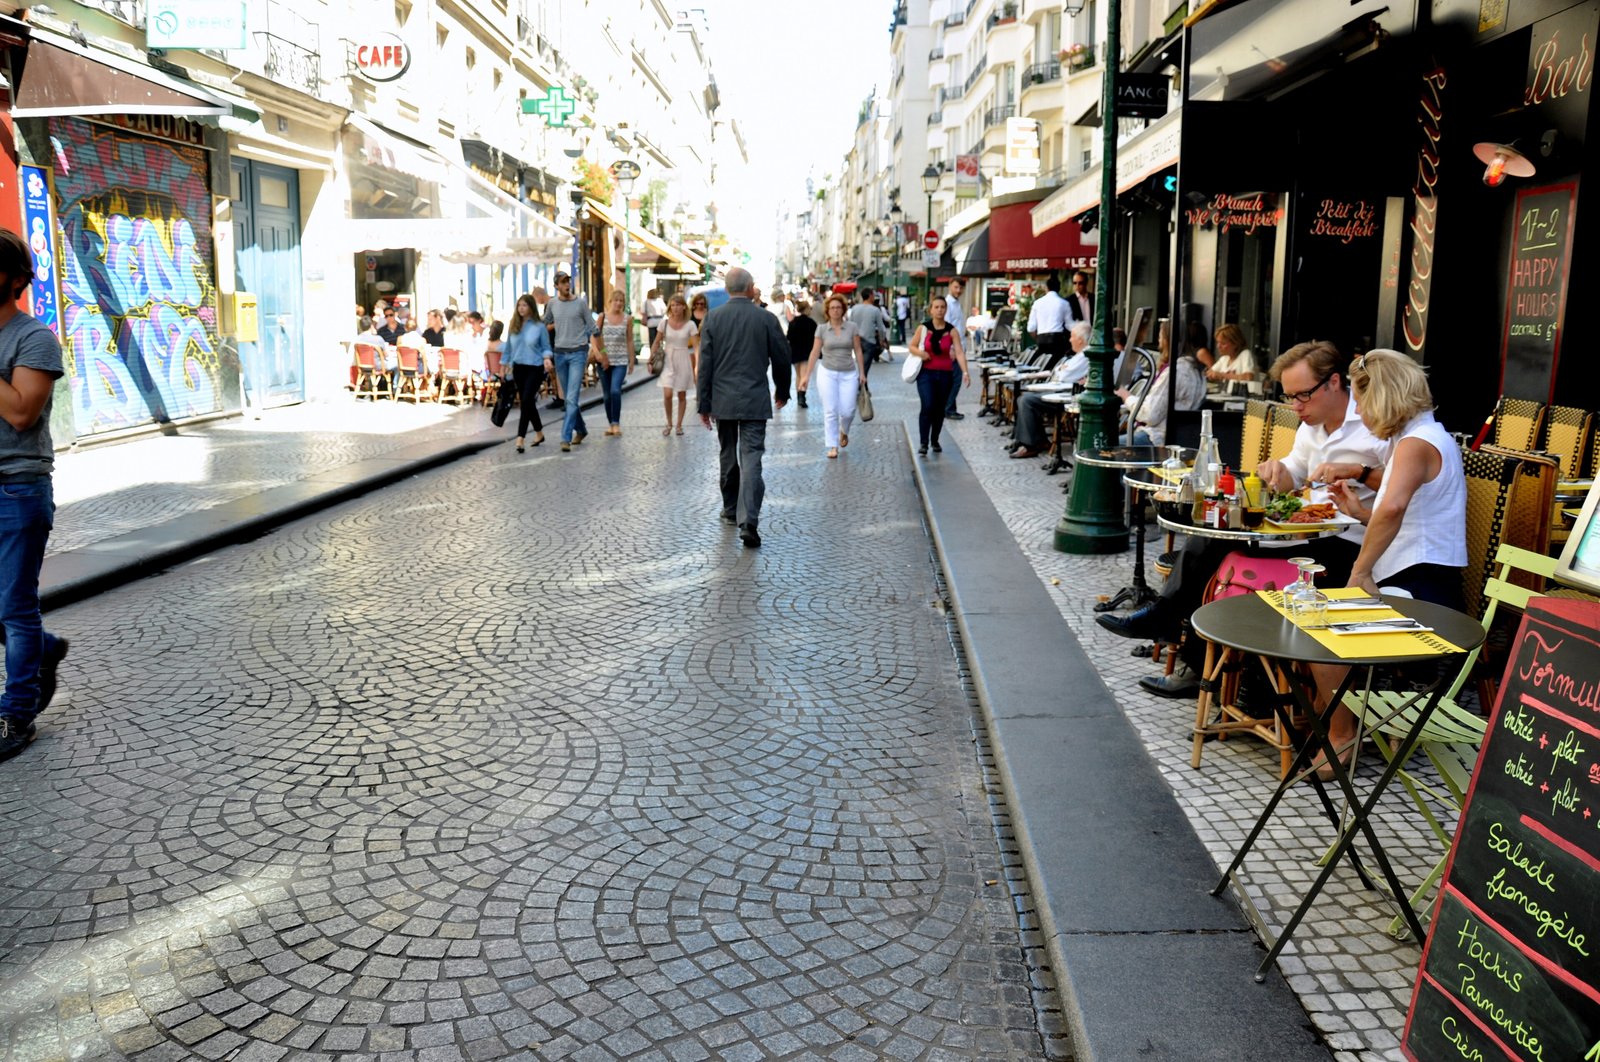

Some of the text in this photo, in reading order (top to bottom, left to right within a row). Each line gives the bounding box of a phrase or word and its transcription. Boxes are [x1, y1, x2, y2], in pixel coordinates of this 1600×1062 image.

[357, 45, 403, 67] CAFE
[1524, 30, 1593, 106] Bar
[1207, 192, 1264, 211] Brunch
[1316, 199, 1353, 219] Petit
[1402, 58, 1447, 350] Cocktails
[1309, 219, 1379, 244] Breakfast
[1006, 258, 1049, 270] BRASSERIE
[1514, 256, 1558, 288] HAPPY
[35, 297, 46, 317] 5
[45, 291, 53, 304] 2
[1516, 292, 1558, 317] HOURS
[45, 308, 56, 326] 7
[1503, 704, 1534, 742] entrée
[1551, 729, 1585, 776] plat
[1504, 752, 1534, 786] entrée
[1551, 777, 1581, 817] plat
[1488, 822, 1556, 893] Salade
[1486, 868, 1590, 957] fromagère
[1457, 919, 1523, 993] Hachis
[1458, 963, 1544, 1062] Parmentier
